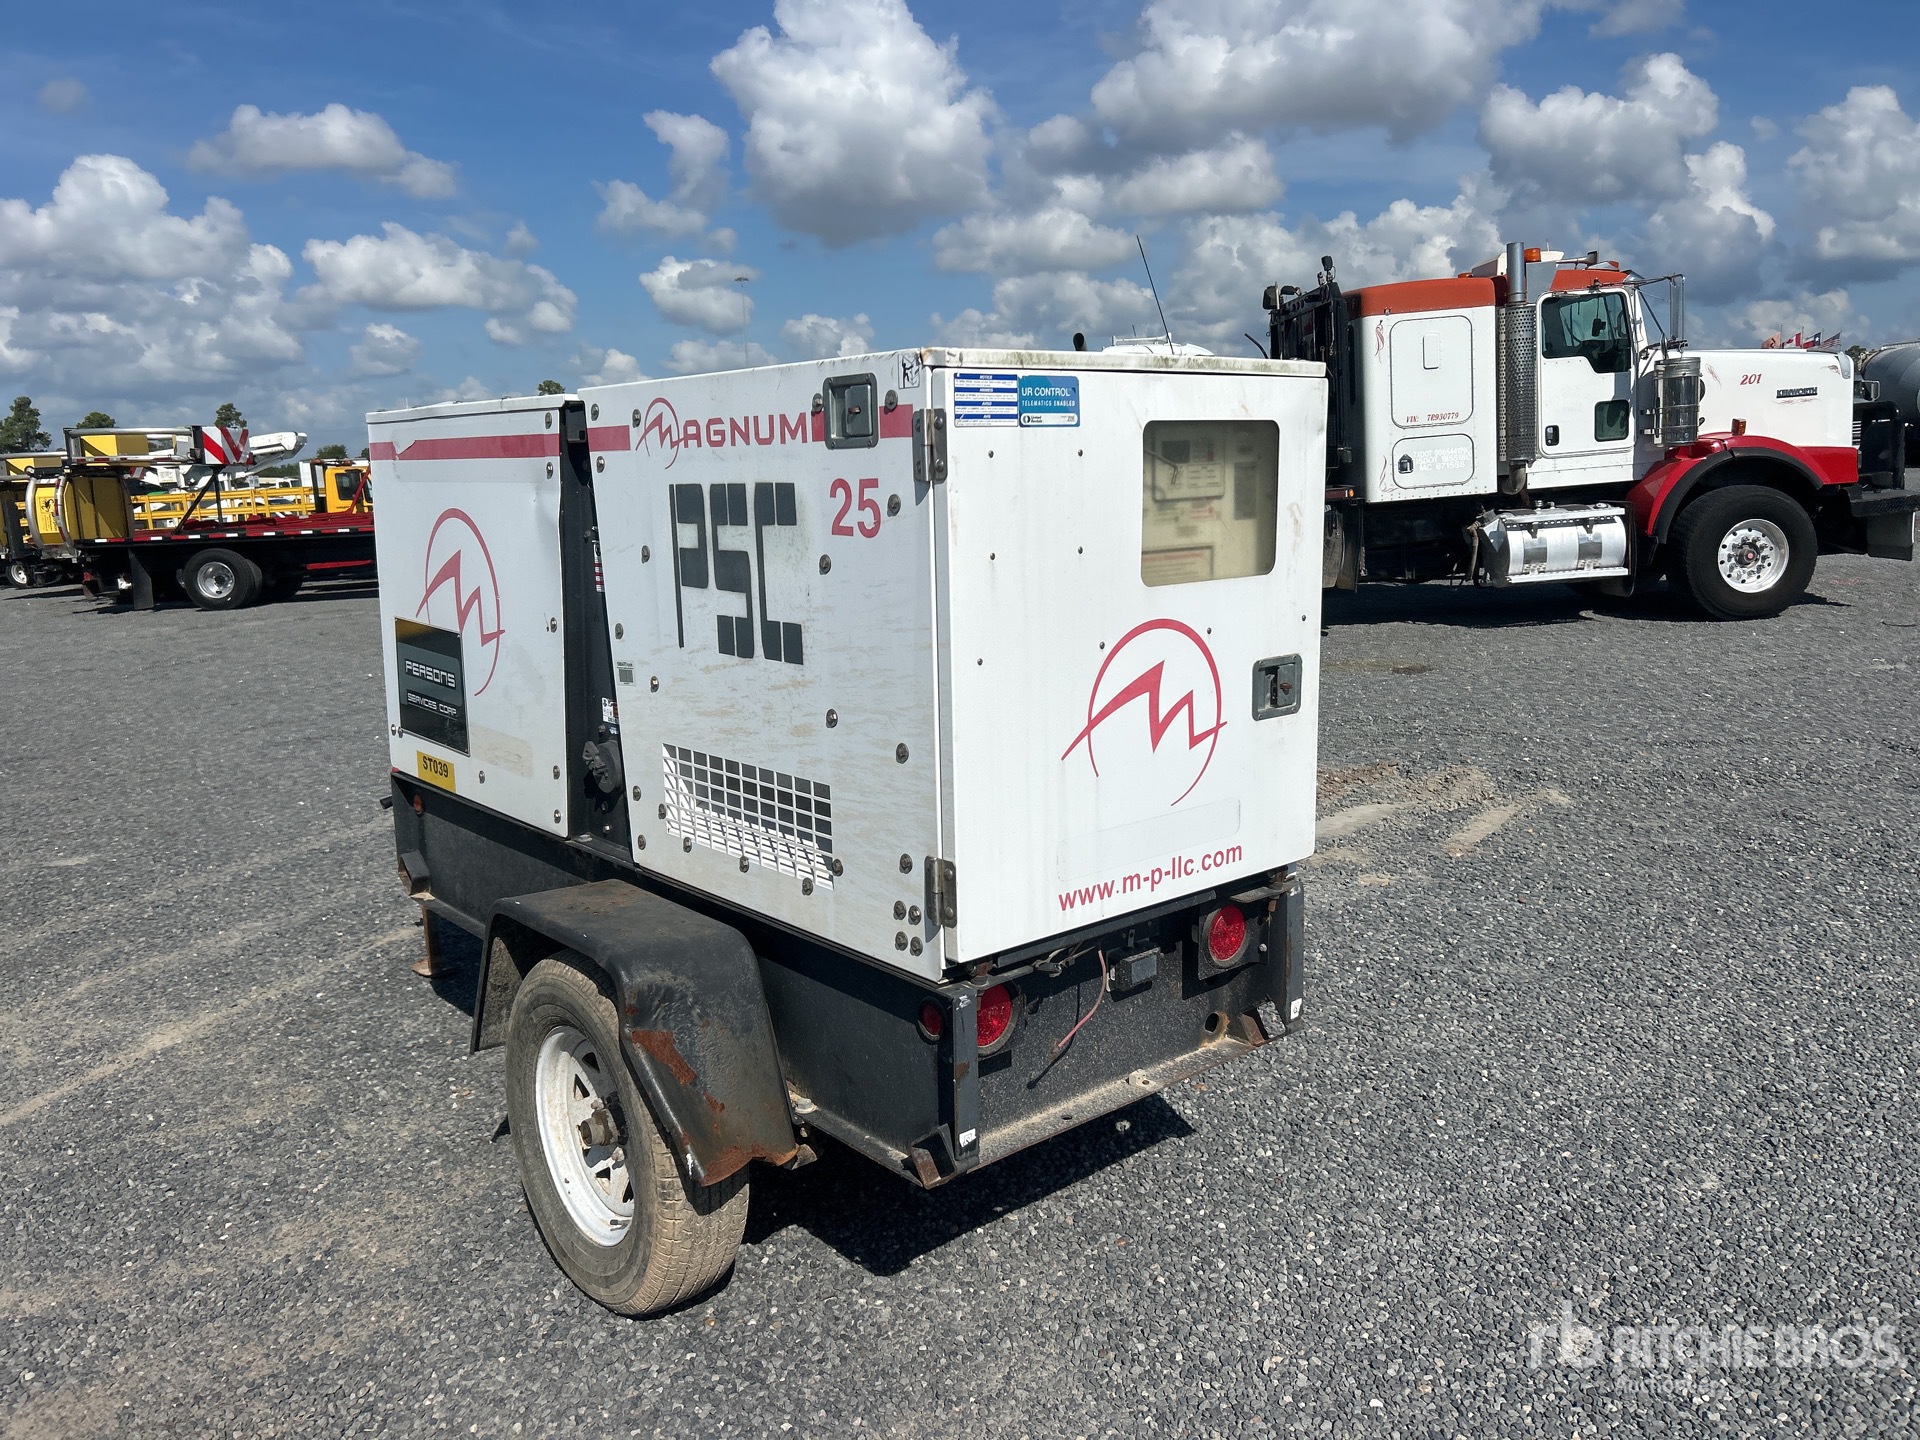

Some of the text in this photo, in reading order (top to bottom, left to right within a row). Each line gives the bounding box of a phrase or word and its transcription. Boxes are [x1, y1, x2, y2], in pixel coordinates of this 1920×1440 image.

[1740, 374, 1761, 385] 201
[1021, 387, 1033, 397] UR
[1034, 387, 1070, 397] CONTROL
[1777, 387, 1817, 398] KENWORTH
[1406, 415, 1420, 423] VIN:
[636, 399, 807, 462] MAGNUM
[1419, 463, 1433, 471] MC
[829, 478, 881, 539] 25
[669, 482, 804, 666] PSC
[405, 660, 456, 688] PERSONS
[407, 692, 437, 710] SERVICES
[422, 755, 449, 778] ST039
[1058, 845, 1242, 911] www.m-p-llc.com
